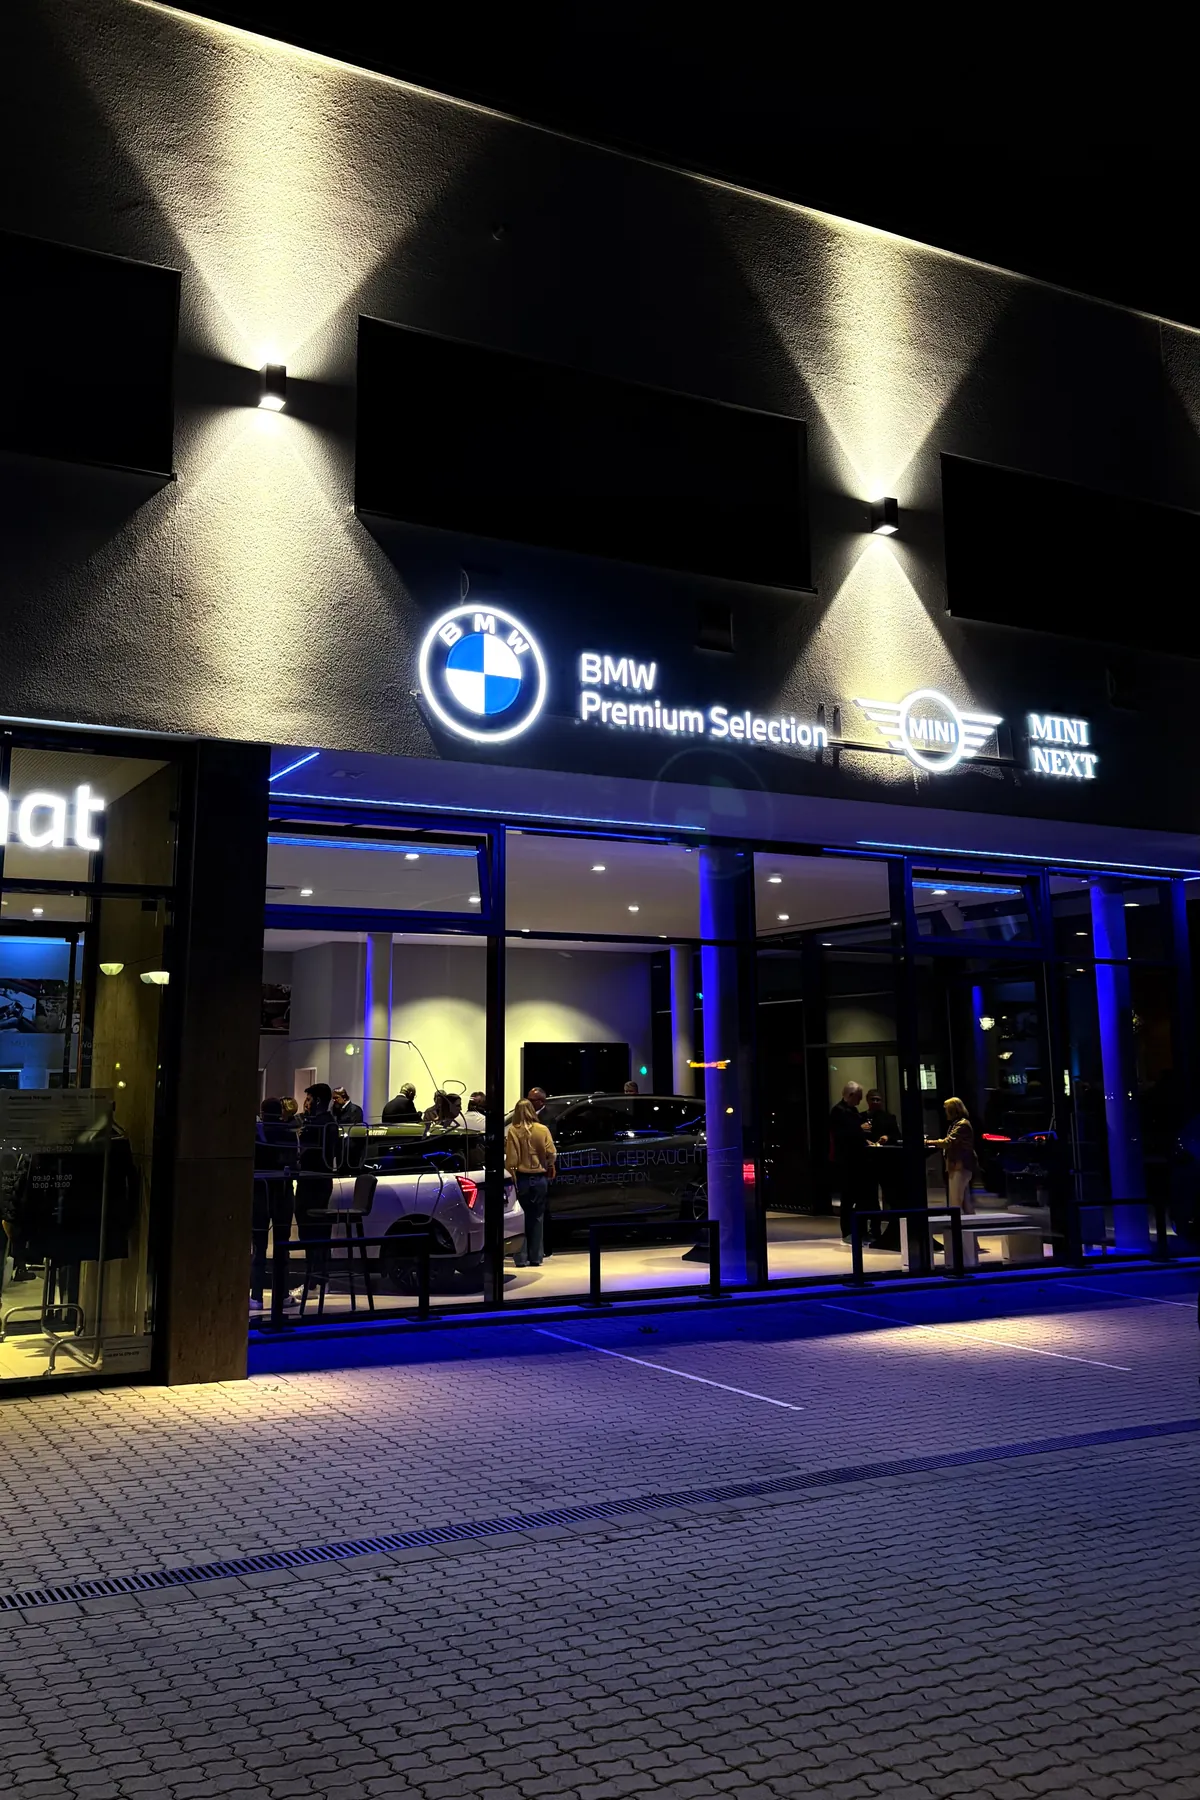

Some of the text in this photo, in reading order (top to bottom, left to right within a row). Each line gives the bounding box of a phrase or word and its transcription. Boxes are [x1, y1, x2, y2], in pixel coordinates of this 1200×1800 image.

[438, 612, 529, 656] BMW
[580, 652, 657, 691] BMW
[581, 690, 829, 749] Premium Selection
[909, 717, 957, 743] MINI
[1028, 712, 1090, 746] MINI
[1032, 746, 1097, 779] NEXT
